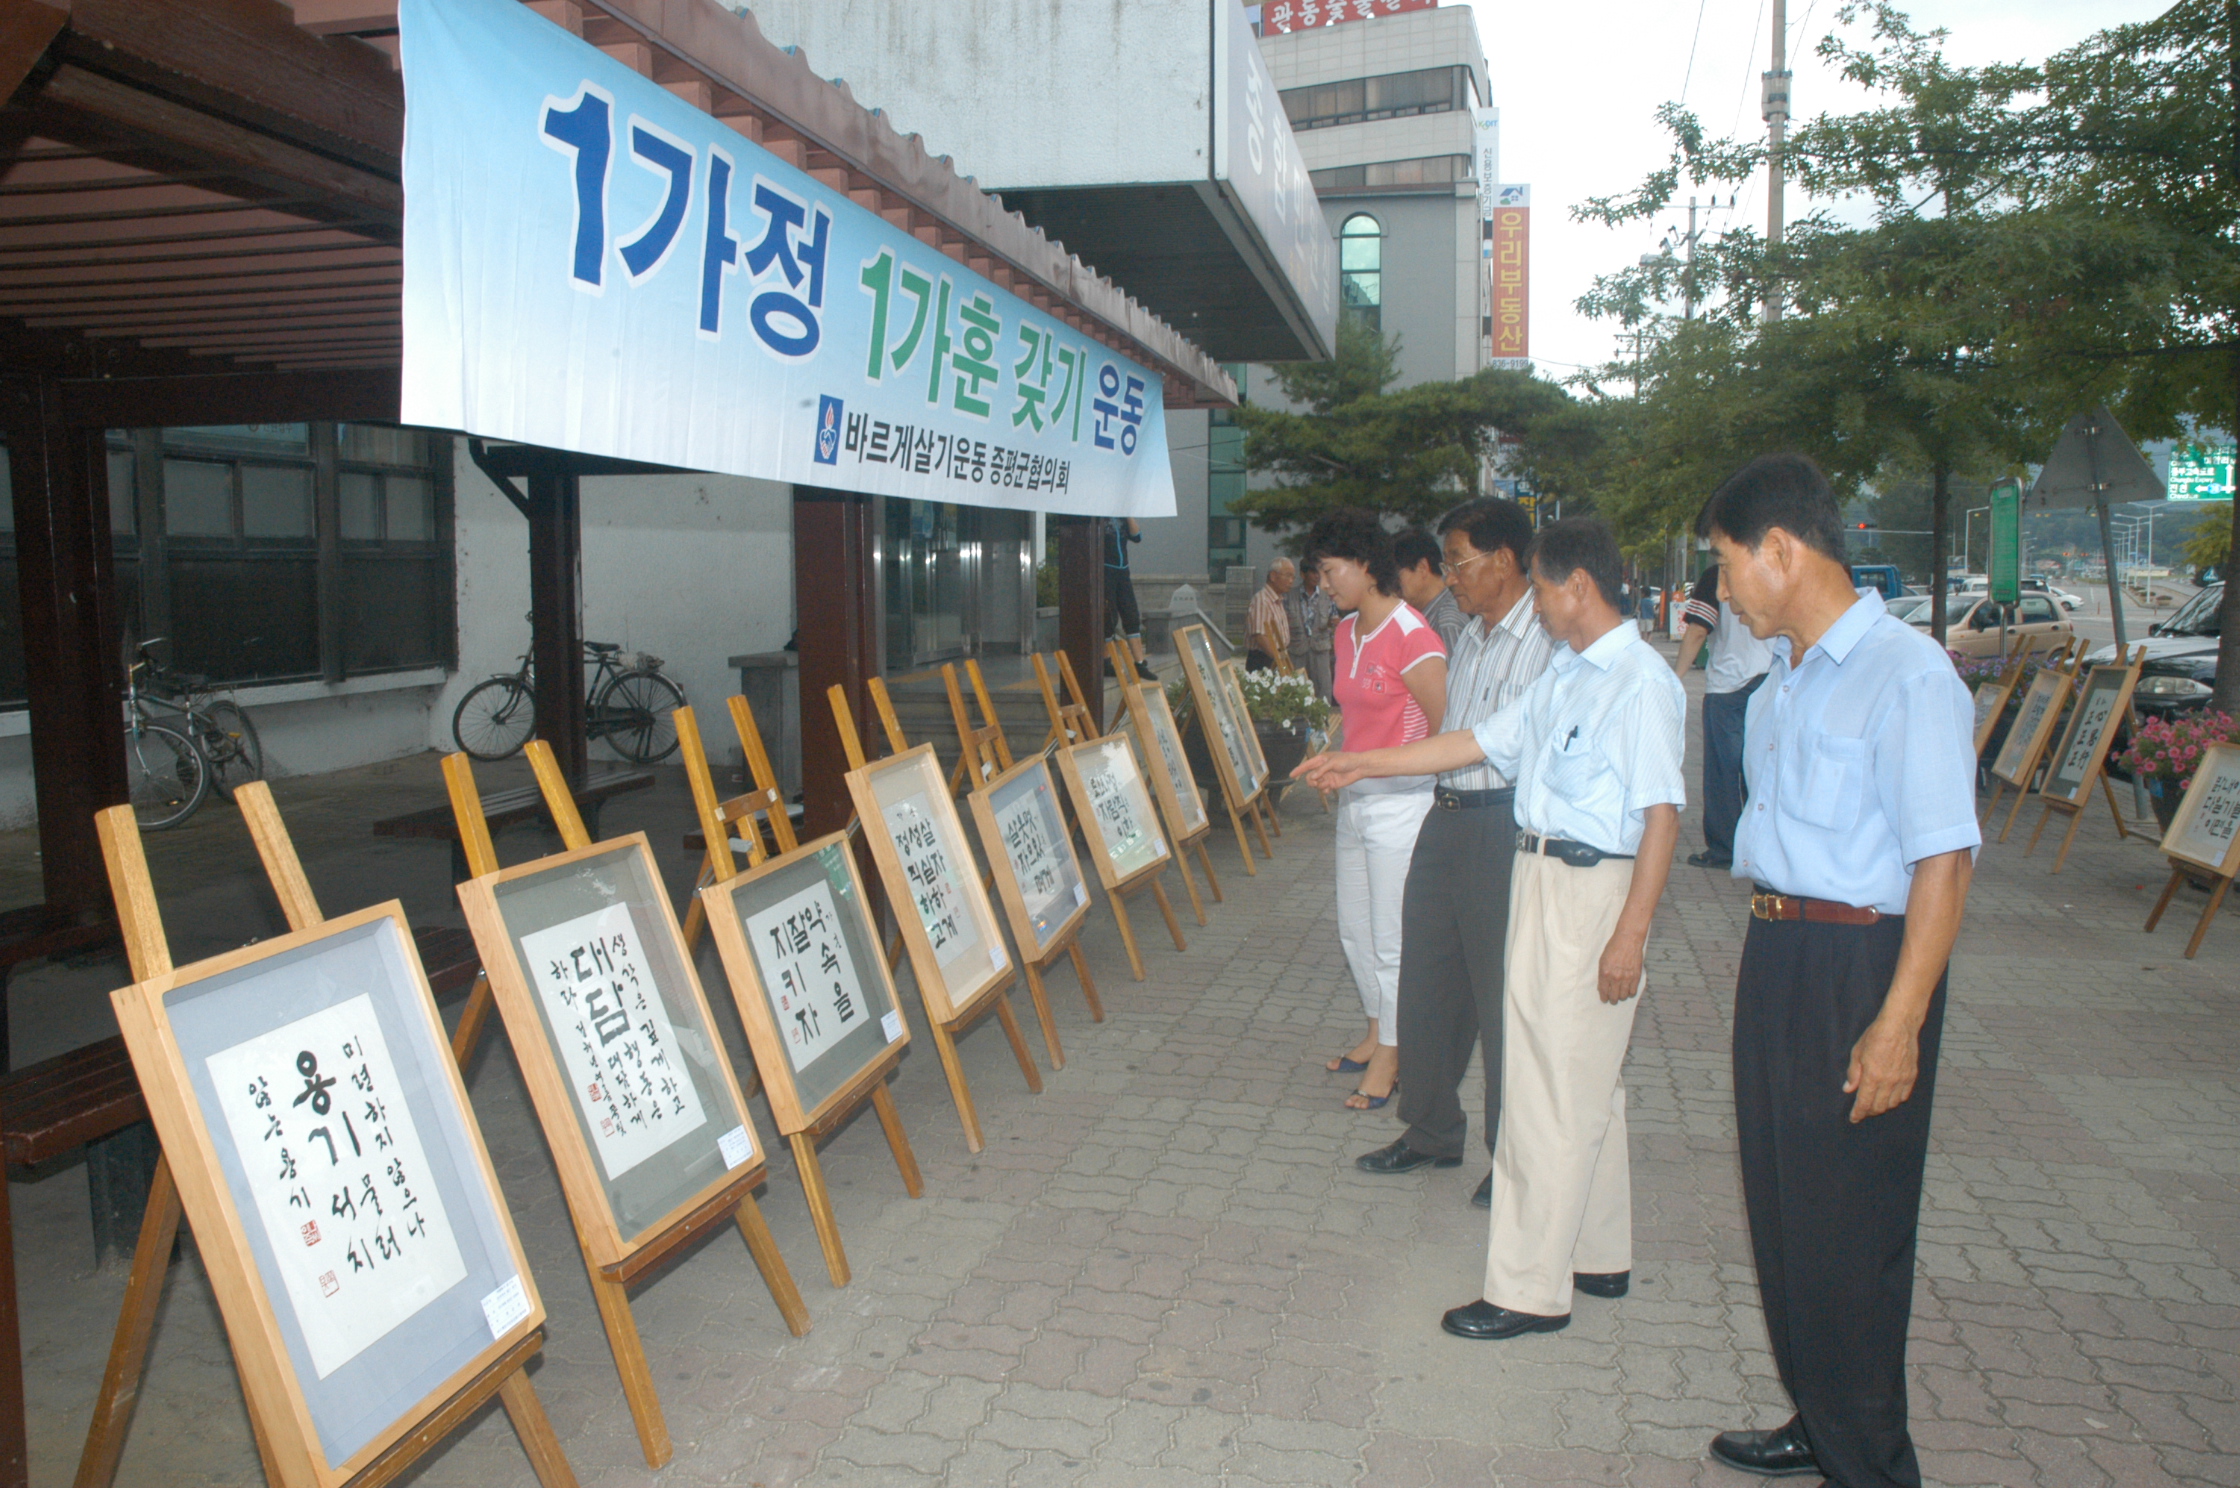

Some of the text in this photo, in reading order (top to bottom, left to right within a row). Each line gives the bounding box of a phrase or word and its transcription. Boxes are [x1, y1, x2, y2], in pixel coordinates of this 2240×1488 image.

[543, 90, 1145, 456] 1가정 1가훈 갖기 운동
[1499, 212, 1523, 352] 우리부동산
[844, 412, 1071, 494] 바르게살기운동 증평군협의회
[570, 937, 630, 1048] 대담
[769, 921, 821, 1045] 지키자
[804, 900, 855, 1023] 약속을
[612, 933, 685, 1116] 생각은 깊게 하고
[623, 1040, 663, 1121] 행동은
[248, 1076, 284, 1142] 않는
[279, 1147, 312, 1209] 용기
[292, 1050, 362, 1167] 용기
[342, 1035, 426, 1238] 미련하지 않으나
